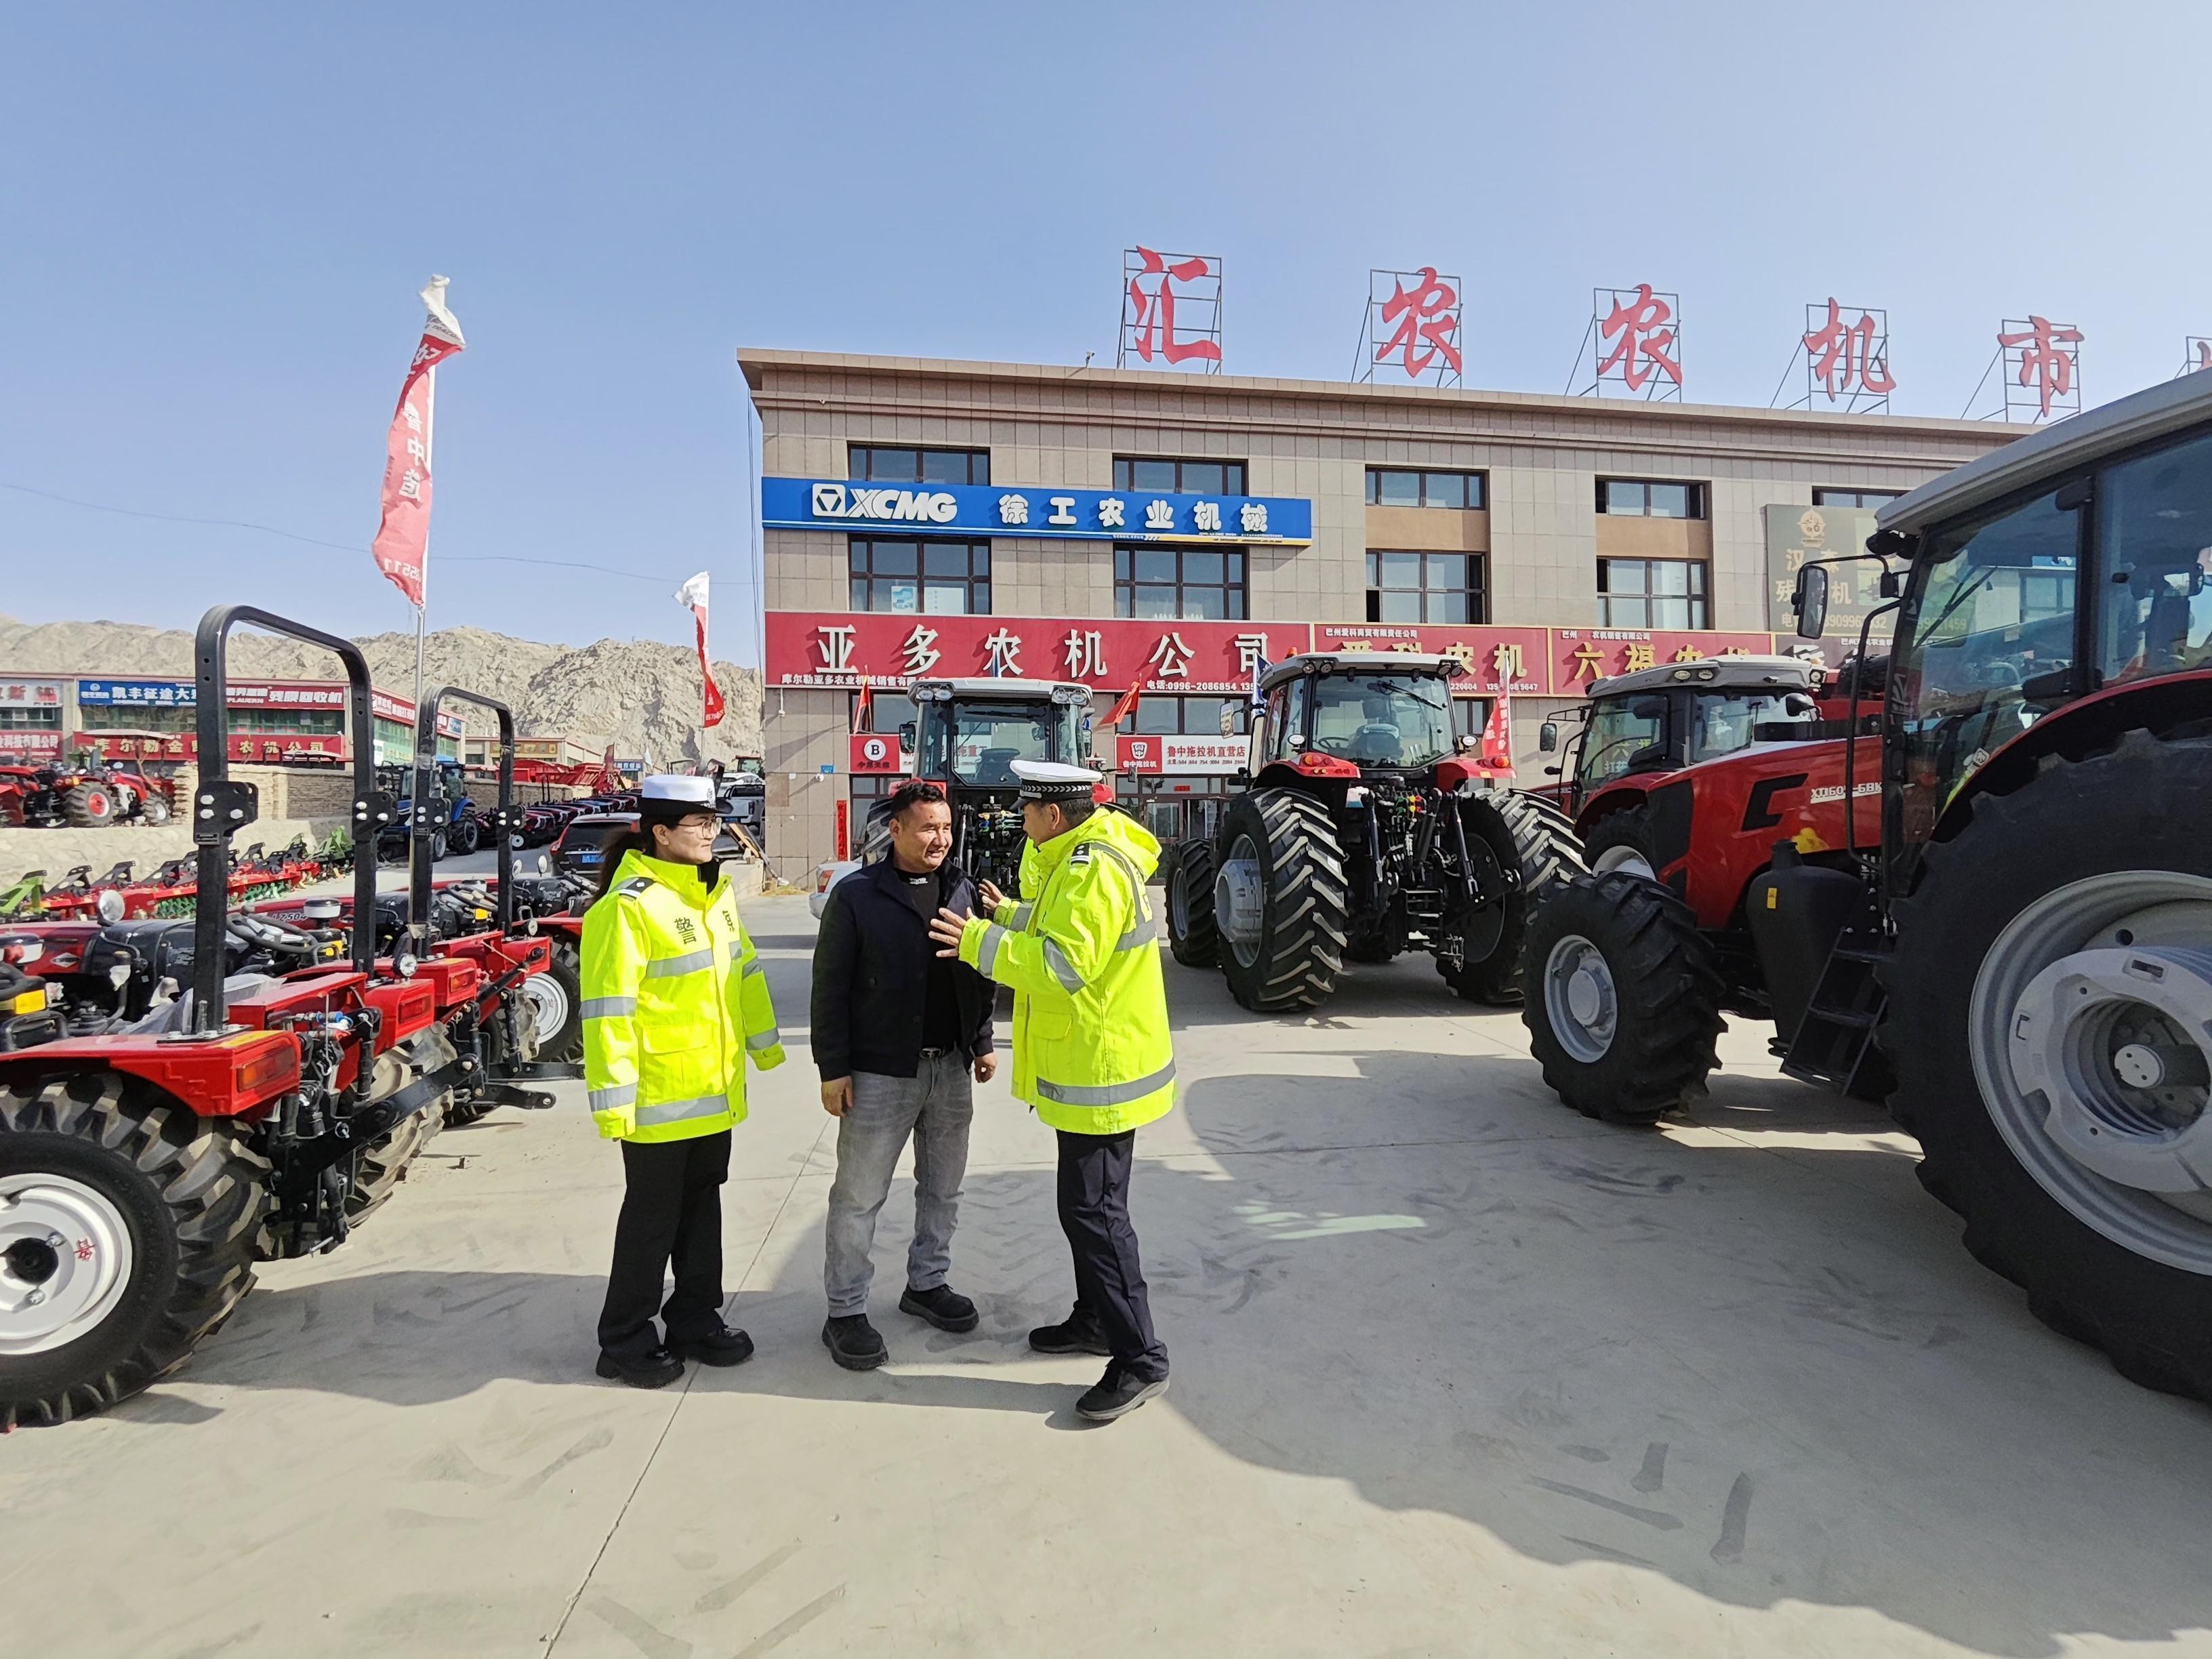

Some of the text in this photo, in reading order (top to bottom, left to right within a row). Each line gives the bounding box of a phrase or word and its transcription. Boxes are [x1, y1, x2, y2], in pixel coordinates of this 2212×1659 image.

[1130, 245, 2212, 417] 汇农农机市
[846, 488, 958, 523] XCMG
[999, 494, 1268, 532] 徐工农业机械
[1775, 579, 1852, 605] 残机
[815, 623, 1268, 678] 亚多农机公司
[1341, 640, 1528, 678] 农机
[1574, 642, 1750, 680] 六福
[781, 674, 938, 687] 库尔勒亚多农业机械销售有限
[0, 735, 58, 748] 科技有限公司
[95, 739, 323, 754] 库尔勒金农机公司
[870, 744, 880, 756] B
[1167, 745, 1246, 757] 鲁中拖拉机直营店
